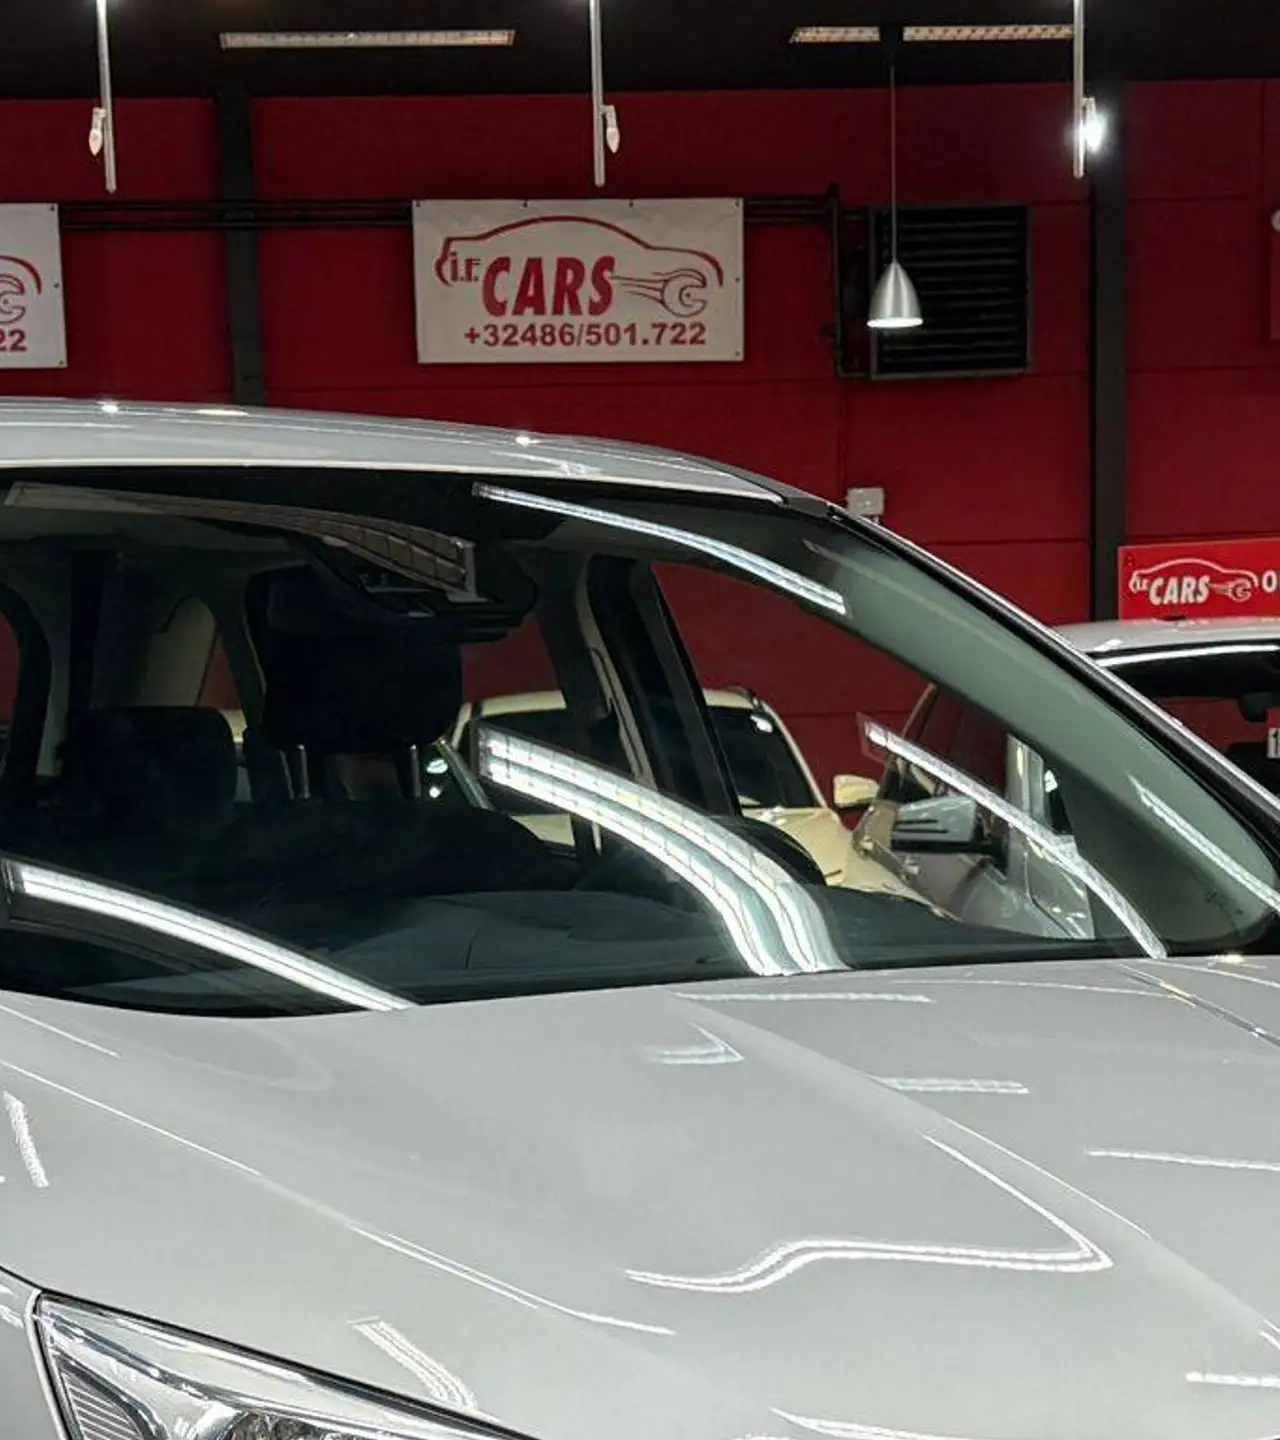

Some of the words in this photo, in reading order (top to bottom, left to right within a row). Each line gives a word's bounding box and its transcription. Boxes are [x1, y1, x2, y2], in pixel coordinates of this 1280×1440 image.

[482, 255, 615, 316] CARS
[463, 323, 706, 346] +32486/501.722
[1149, 574, 1210, 605] CARS
